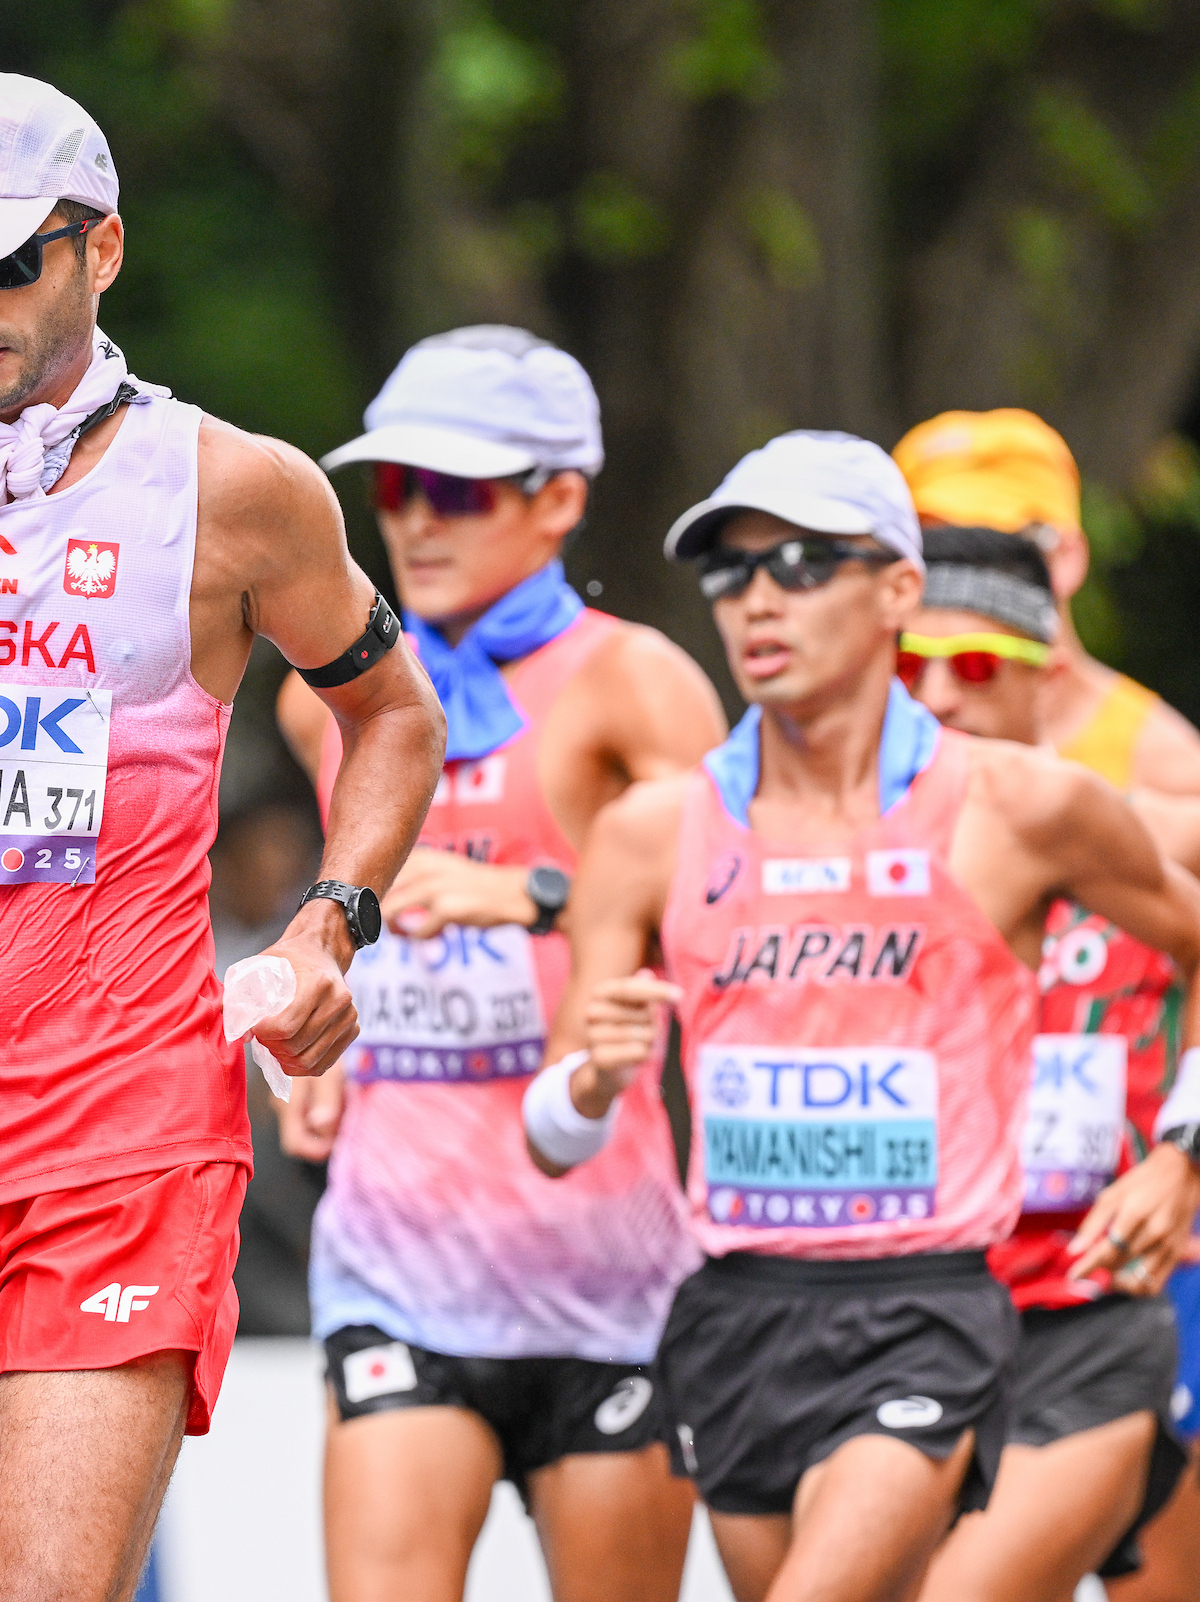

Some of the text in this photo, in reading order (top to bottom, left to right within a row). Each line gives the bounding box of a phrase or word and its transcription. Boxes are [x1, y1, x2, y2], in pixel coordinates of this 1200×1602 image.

[44, 786, 96, 831] 371
[713, 930, 920, 988] JAPAN
[753, 1060, 907, 1108] TDK
[80, 1282, 160, 1323] 4F
